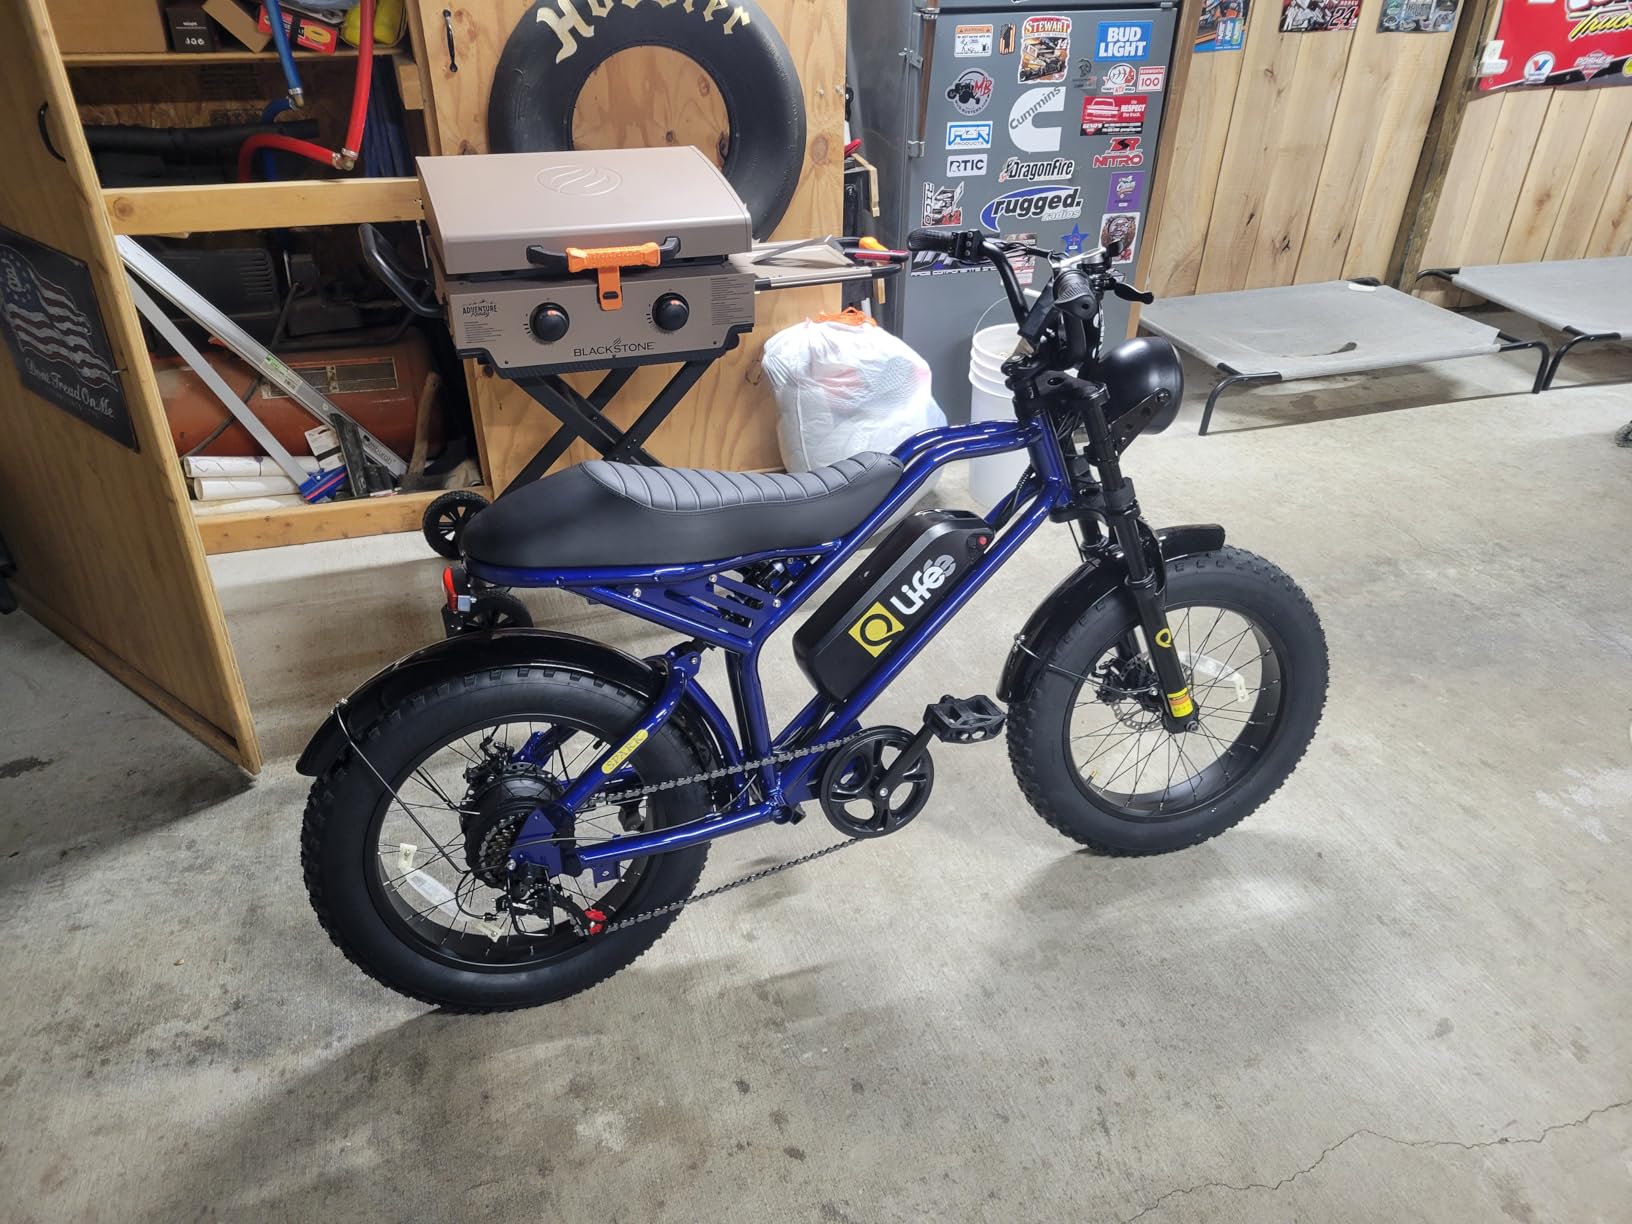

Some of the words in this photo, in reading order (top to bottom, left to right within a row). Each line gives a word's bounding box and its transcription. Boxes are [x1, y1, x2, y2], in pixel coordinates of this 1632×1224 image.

[1329, 6, 1358, 27] 24
[1025, 20, 1070, 34] STEWART
[1107, 26, 1142, 42] BUD
[1099, 41, 1147, 57] LIGHT
[1141, 77, 1160, 87] 100
[1009, 86, 1061, 130] Cummins
[1120, 104, 1146, 113] RESPECT
[949, 159, 985, 173] RTIC
[1093, 153, 1144, 168] NITRO
[1006, 159, 1074, 181] DragonFire
[1042, 209, 1081, 220] radios
[932, 267, 981, 275] COMPONENTS
[462, 304, 498, 315] ADVENTURE
[573, 341, 657, 357] BLACKSTONE
